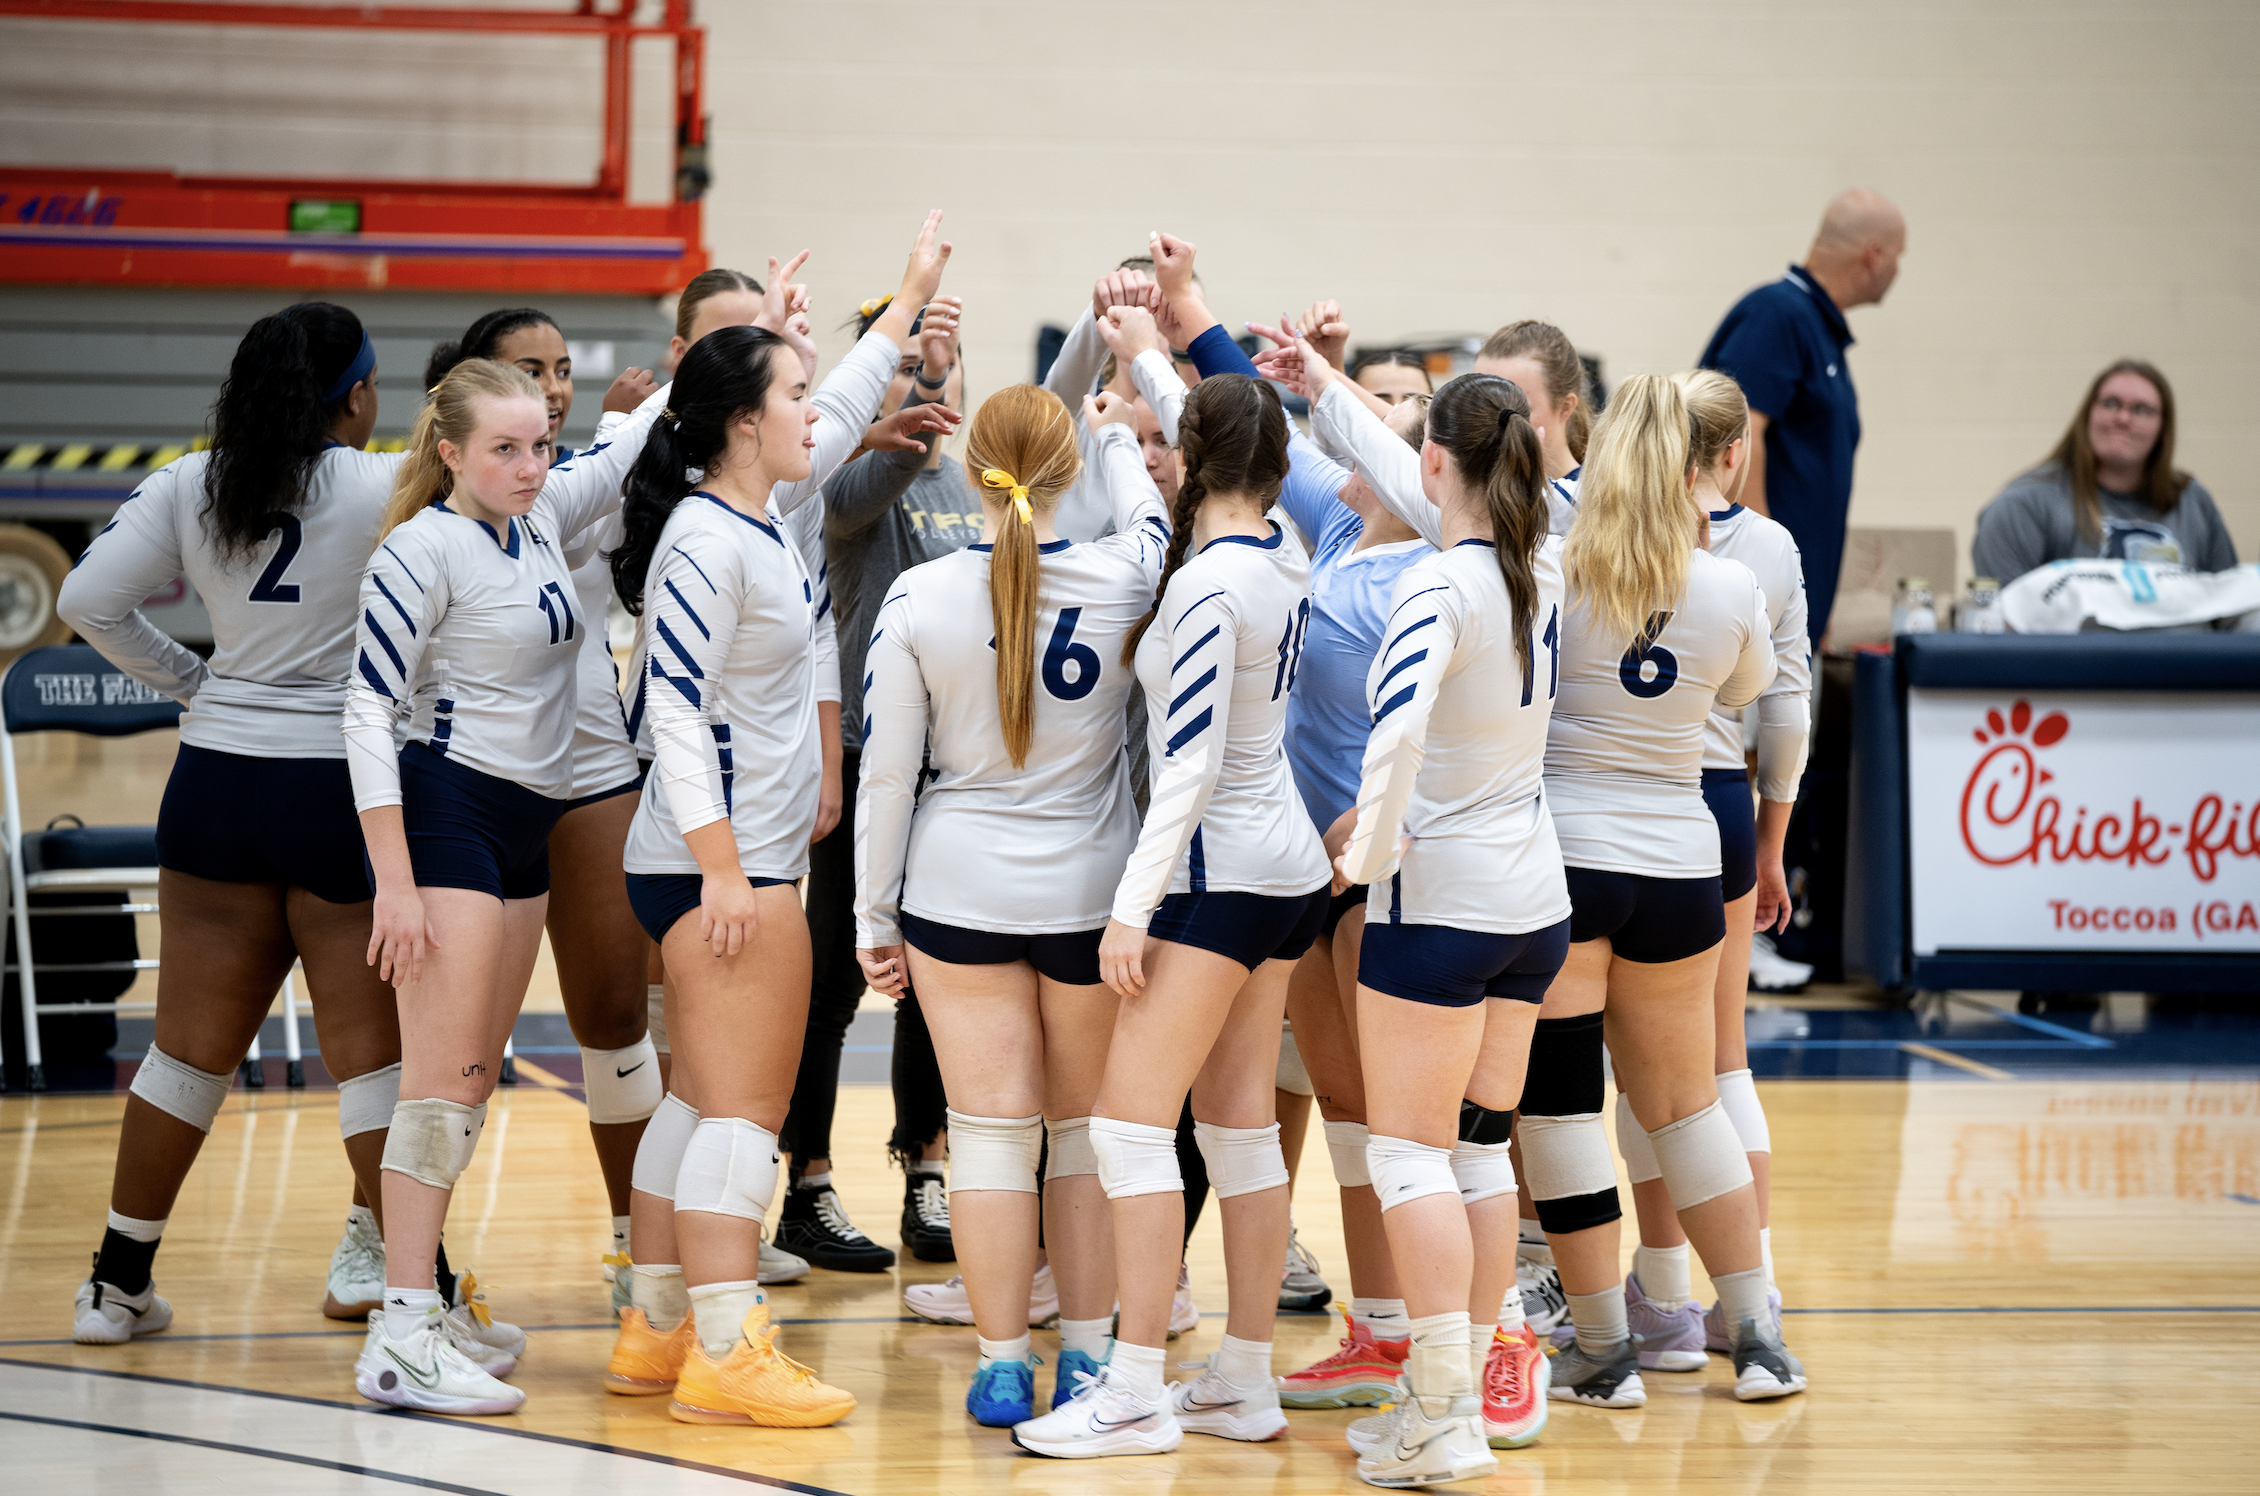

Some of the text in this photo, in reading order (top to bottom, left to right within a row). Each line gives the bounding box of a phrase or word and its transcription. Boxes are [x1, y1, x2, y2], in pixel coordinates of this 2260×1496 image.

[247, 510, 304, 605] 2
[536, 578, 576, 647] 17
[1616, 608, 1680, 701] 6
[34, 673, 97, 706] THE
[2048, 899, 2177, 931] Toccoa
